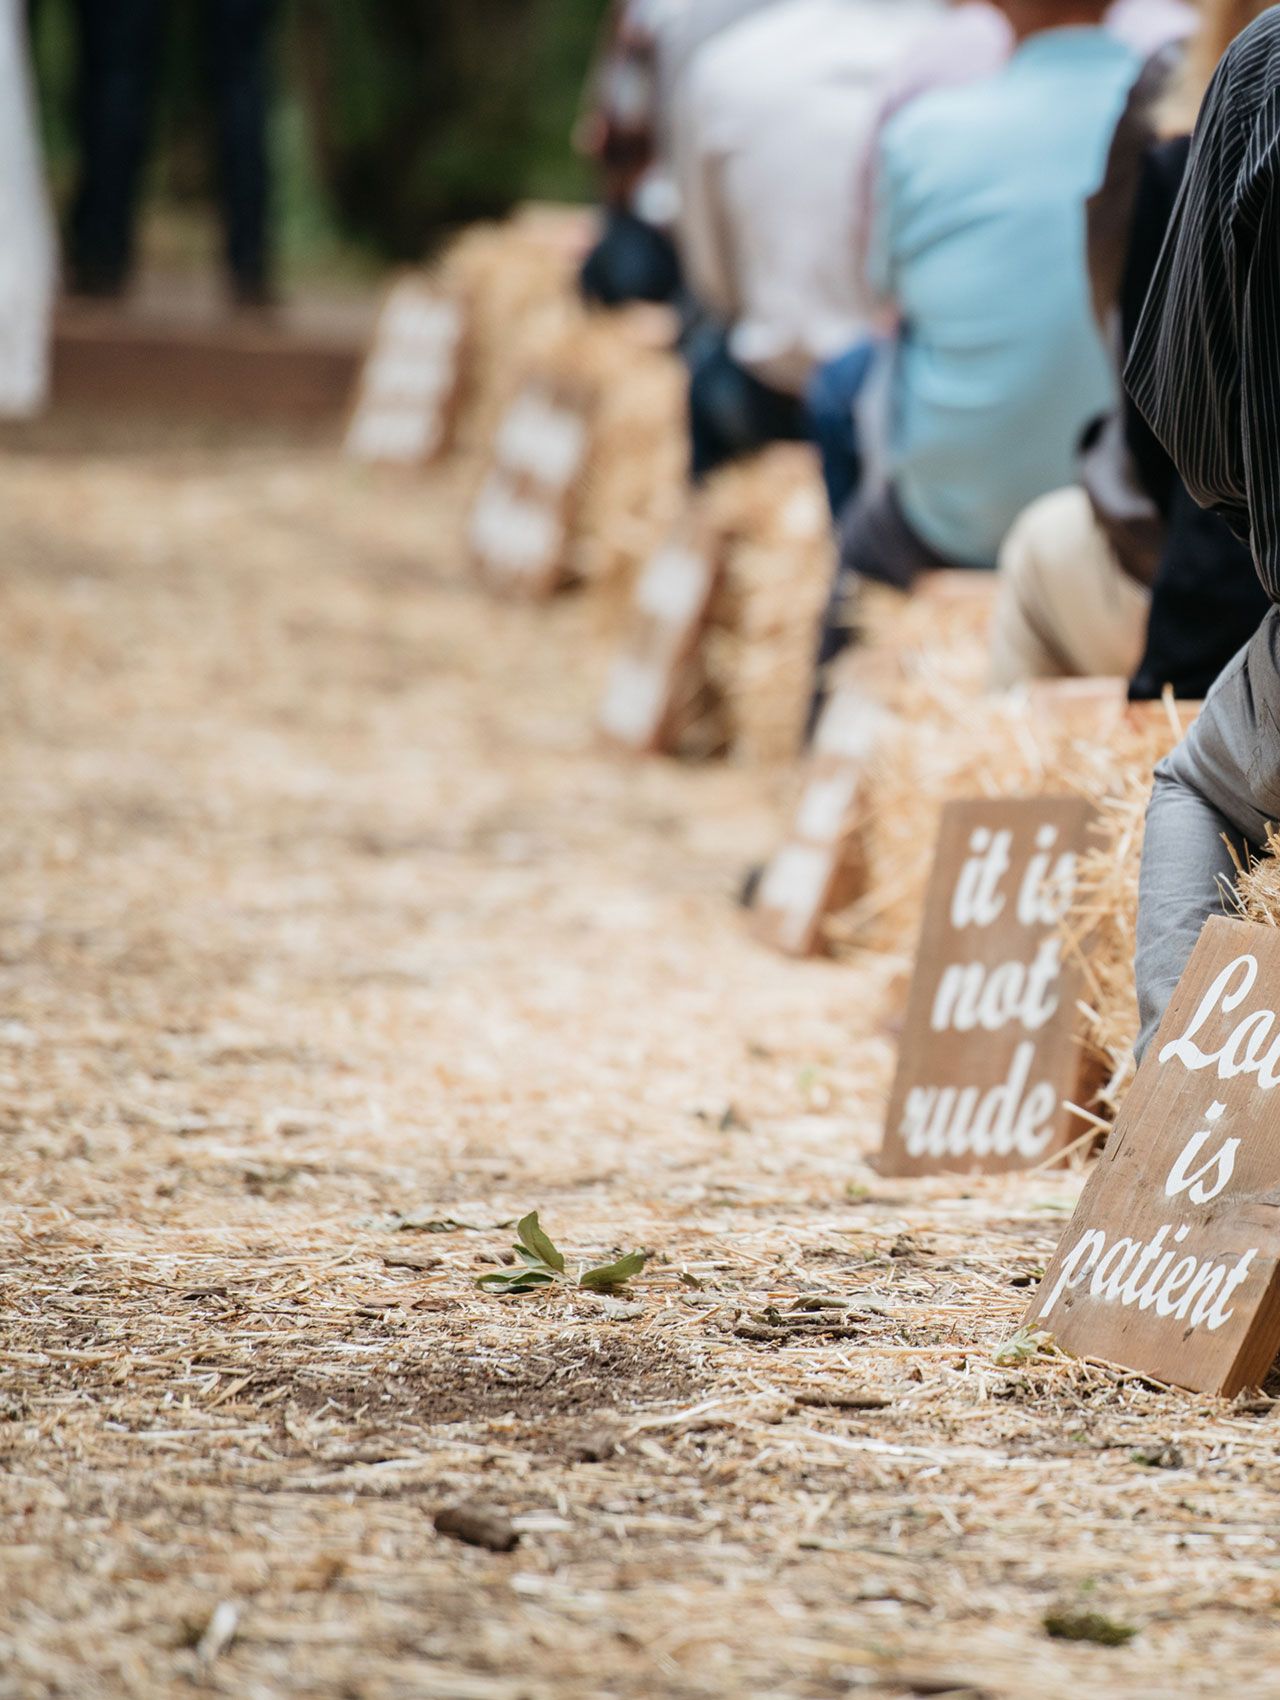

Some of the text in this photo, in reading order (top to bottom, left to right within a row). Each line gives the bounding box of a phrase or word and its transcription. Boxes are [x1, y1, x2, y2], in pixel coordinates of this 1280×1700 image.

[951, 826, 1013, 929] it
[1016, 824, 1078, 926] is
[931, 939, 1064, 1031] not
[902, 1041, 1056, 1158] rude
[1164, 1100, 1242, 1205] is
[1039, 1224, 1259, 1332] patient
